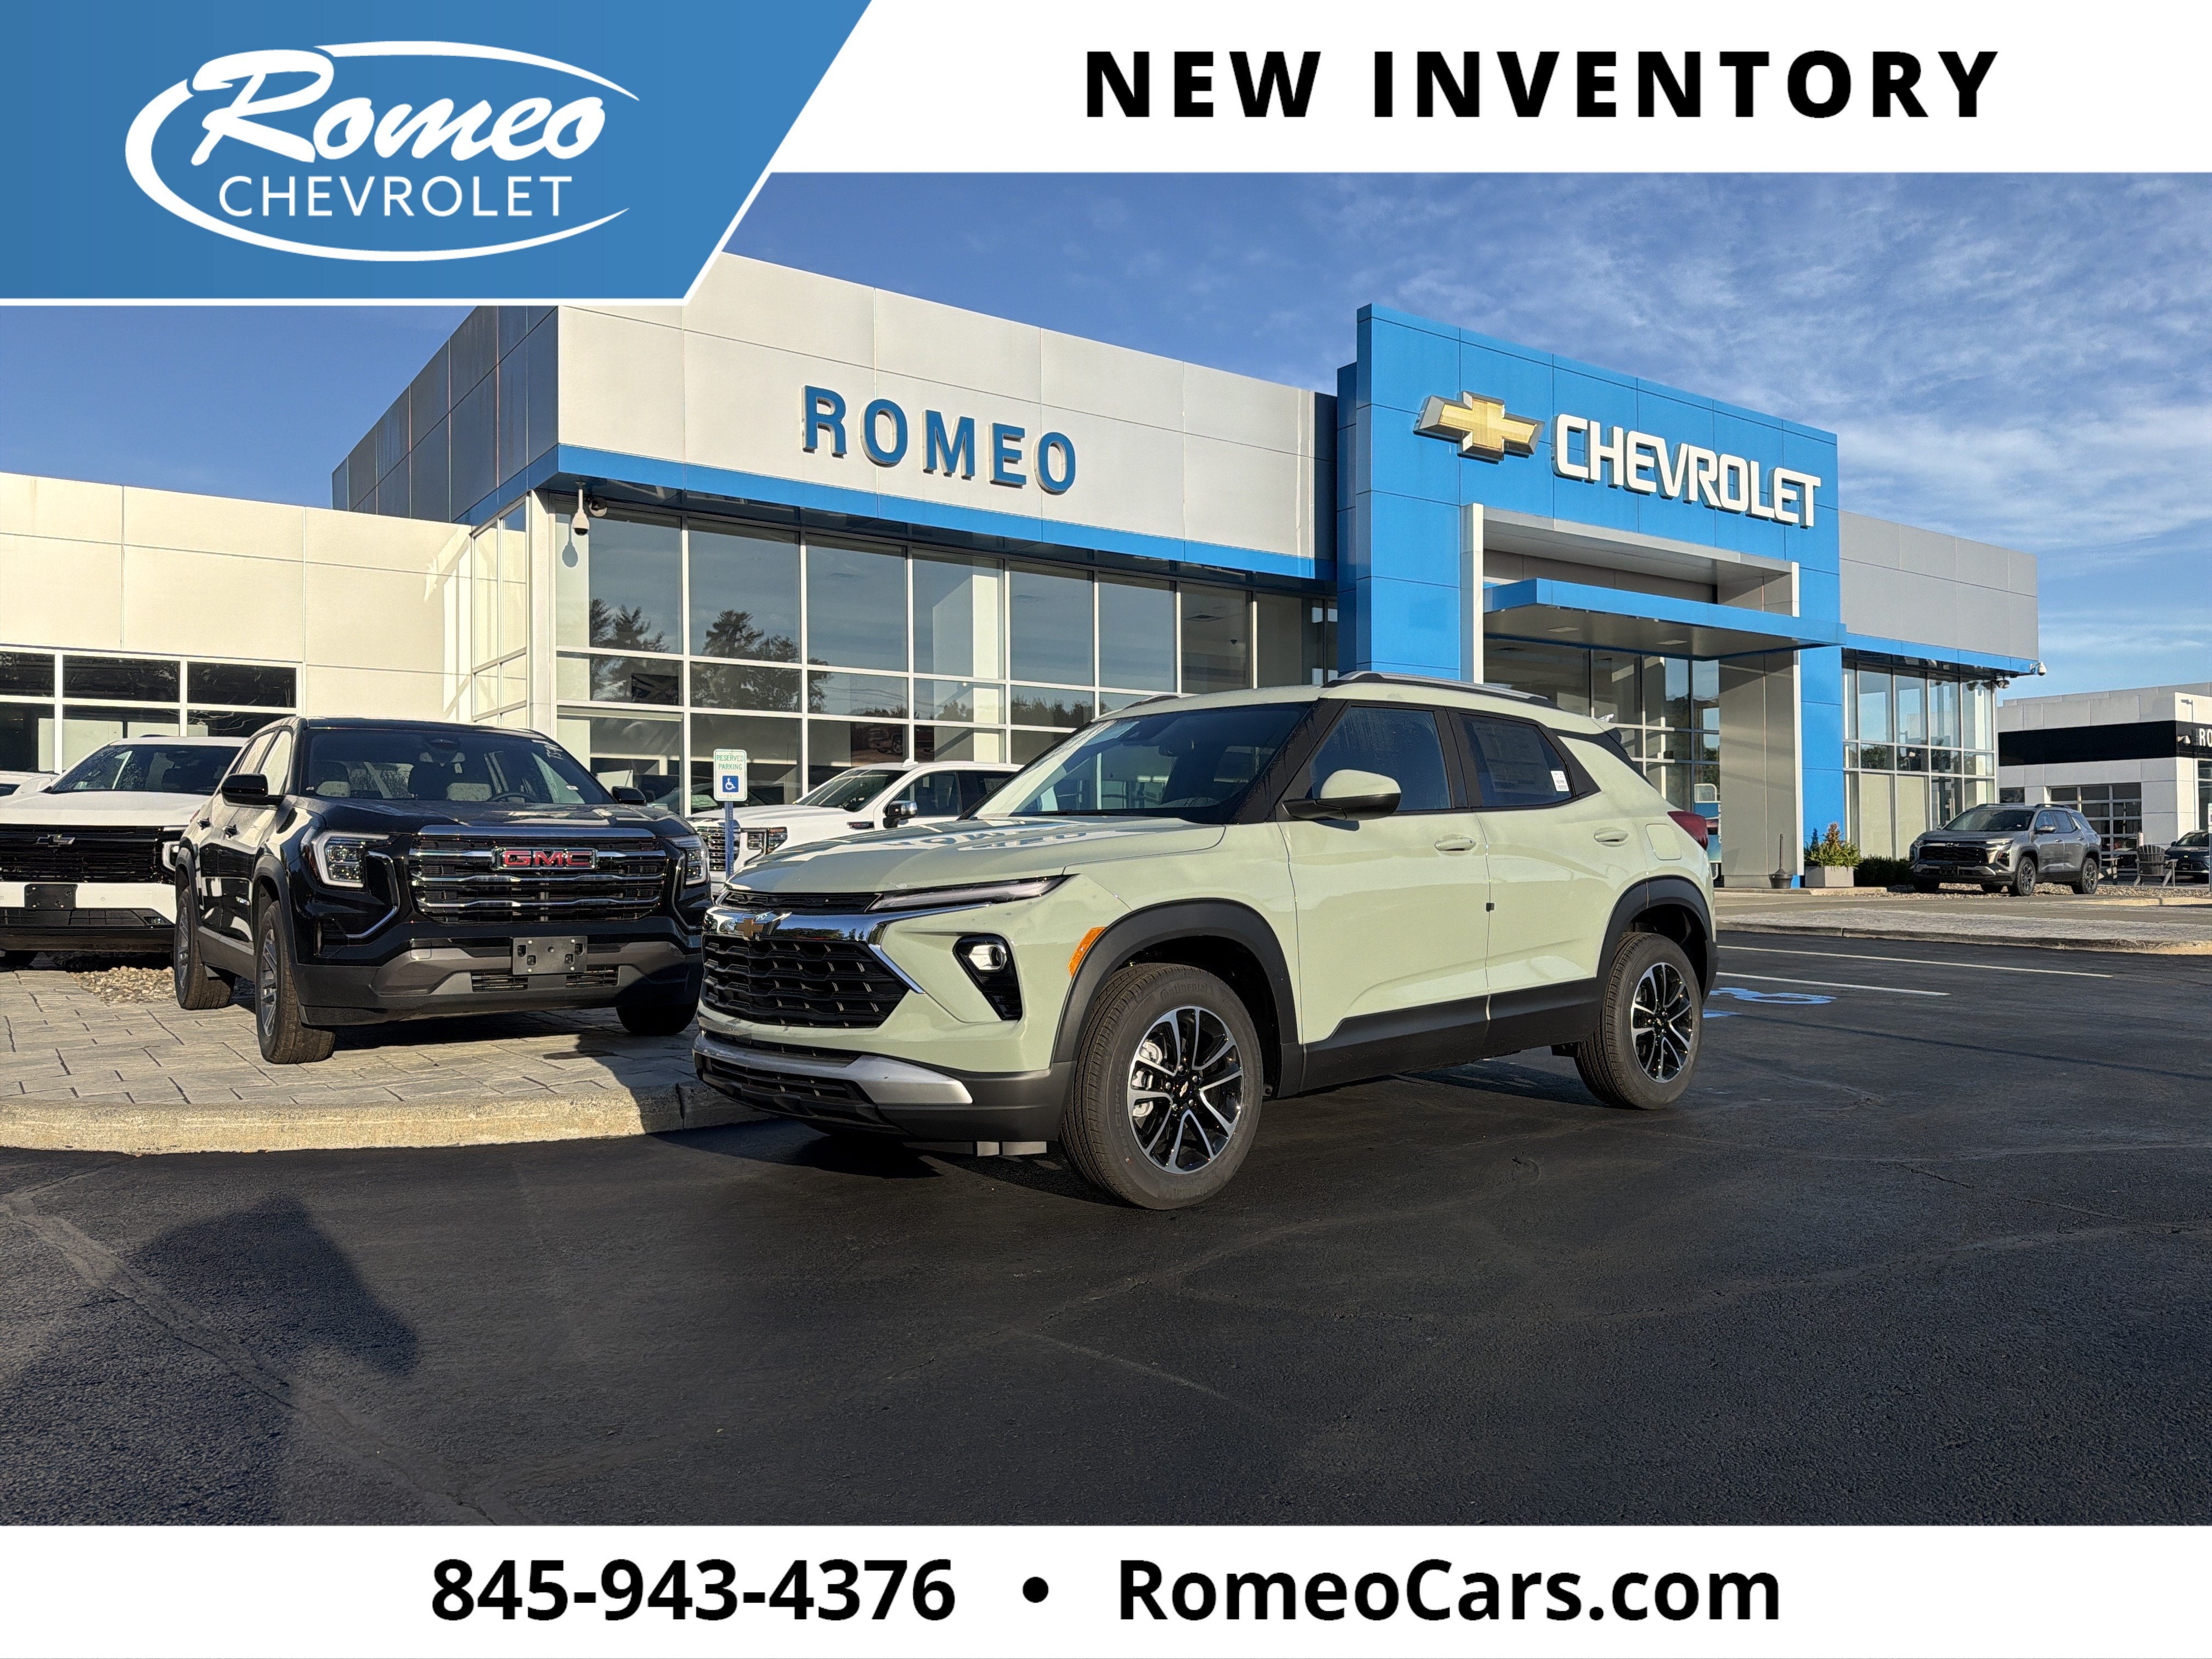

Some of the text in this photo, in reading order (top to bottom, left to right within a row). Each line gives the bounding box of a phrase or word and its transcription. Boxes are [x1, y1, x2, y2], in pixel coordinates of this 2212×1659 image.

[802, 385, 1076, 493] ROMEO
[1553, 413, 1821, 528] CHEVROLET
[503, 850, 593, 866] GMC
